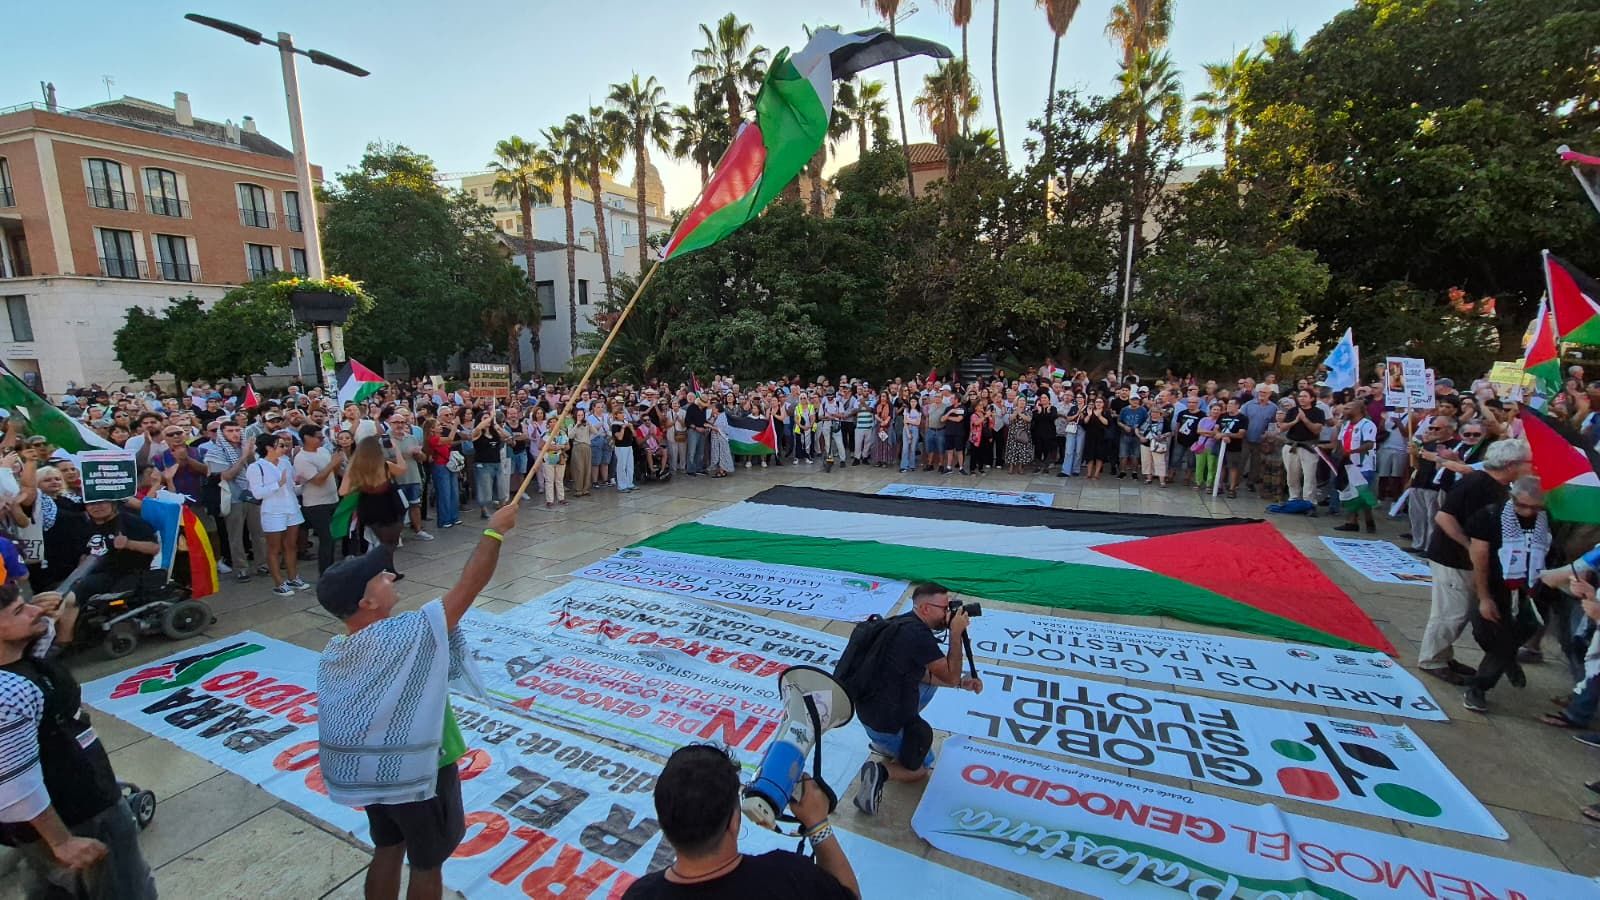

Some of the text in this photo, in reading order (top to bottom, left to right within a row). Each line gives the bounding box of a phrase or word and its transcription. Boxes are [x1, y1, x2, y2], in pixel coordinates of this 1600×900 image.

[584, 568, 695, 591] GENOCIDIO
[706, 579, 785, 596] PUEBLO
[710, 590, 815, 611] PAREMOS
[684, 622, 756, 647] TOTAL
[1031, 620, 1073, 631] ISRAEL
[1042, 628, 1087, 637] ARMAS
[1100, 628, 1175, 642] RELACIONES
[976, 640, 1150, 674] GENOCID
[1003, 628, 1188, 662] PALESTINA
[561, 646, 644, 683] PALESTINO
[656, 662, 753, 694] IMPERIALISTAS
[1162, 664, 1205, 682] EL
[1202, 652, 1257, 672] EN
[515, 676, 652, 719] GENOCIDIO
[645, 678, 716, 700] PUEBLO
[719, 694, 737, 707] EL
[978, 670, 1241, 732] FLOTILL
[1216, 671, 1439, 712] PAREMOS
[141, 687, 300, 755] PARA
[651, 710, 705, 735] DEL
[697, 709, 779, 754] IN
[1013, 698, 1250, 758] SUMUD
[515, 733, 563, 757] de
[966, 710, 1263, 788] GLOBAL
[490, 766, 590, 830] EL
[962, 765, 1227, 845] GENOCIDIO
[1230, 825, 1290, 861] EL
